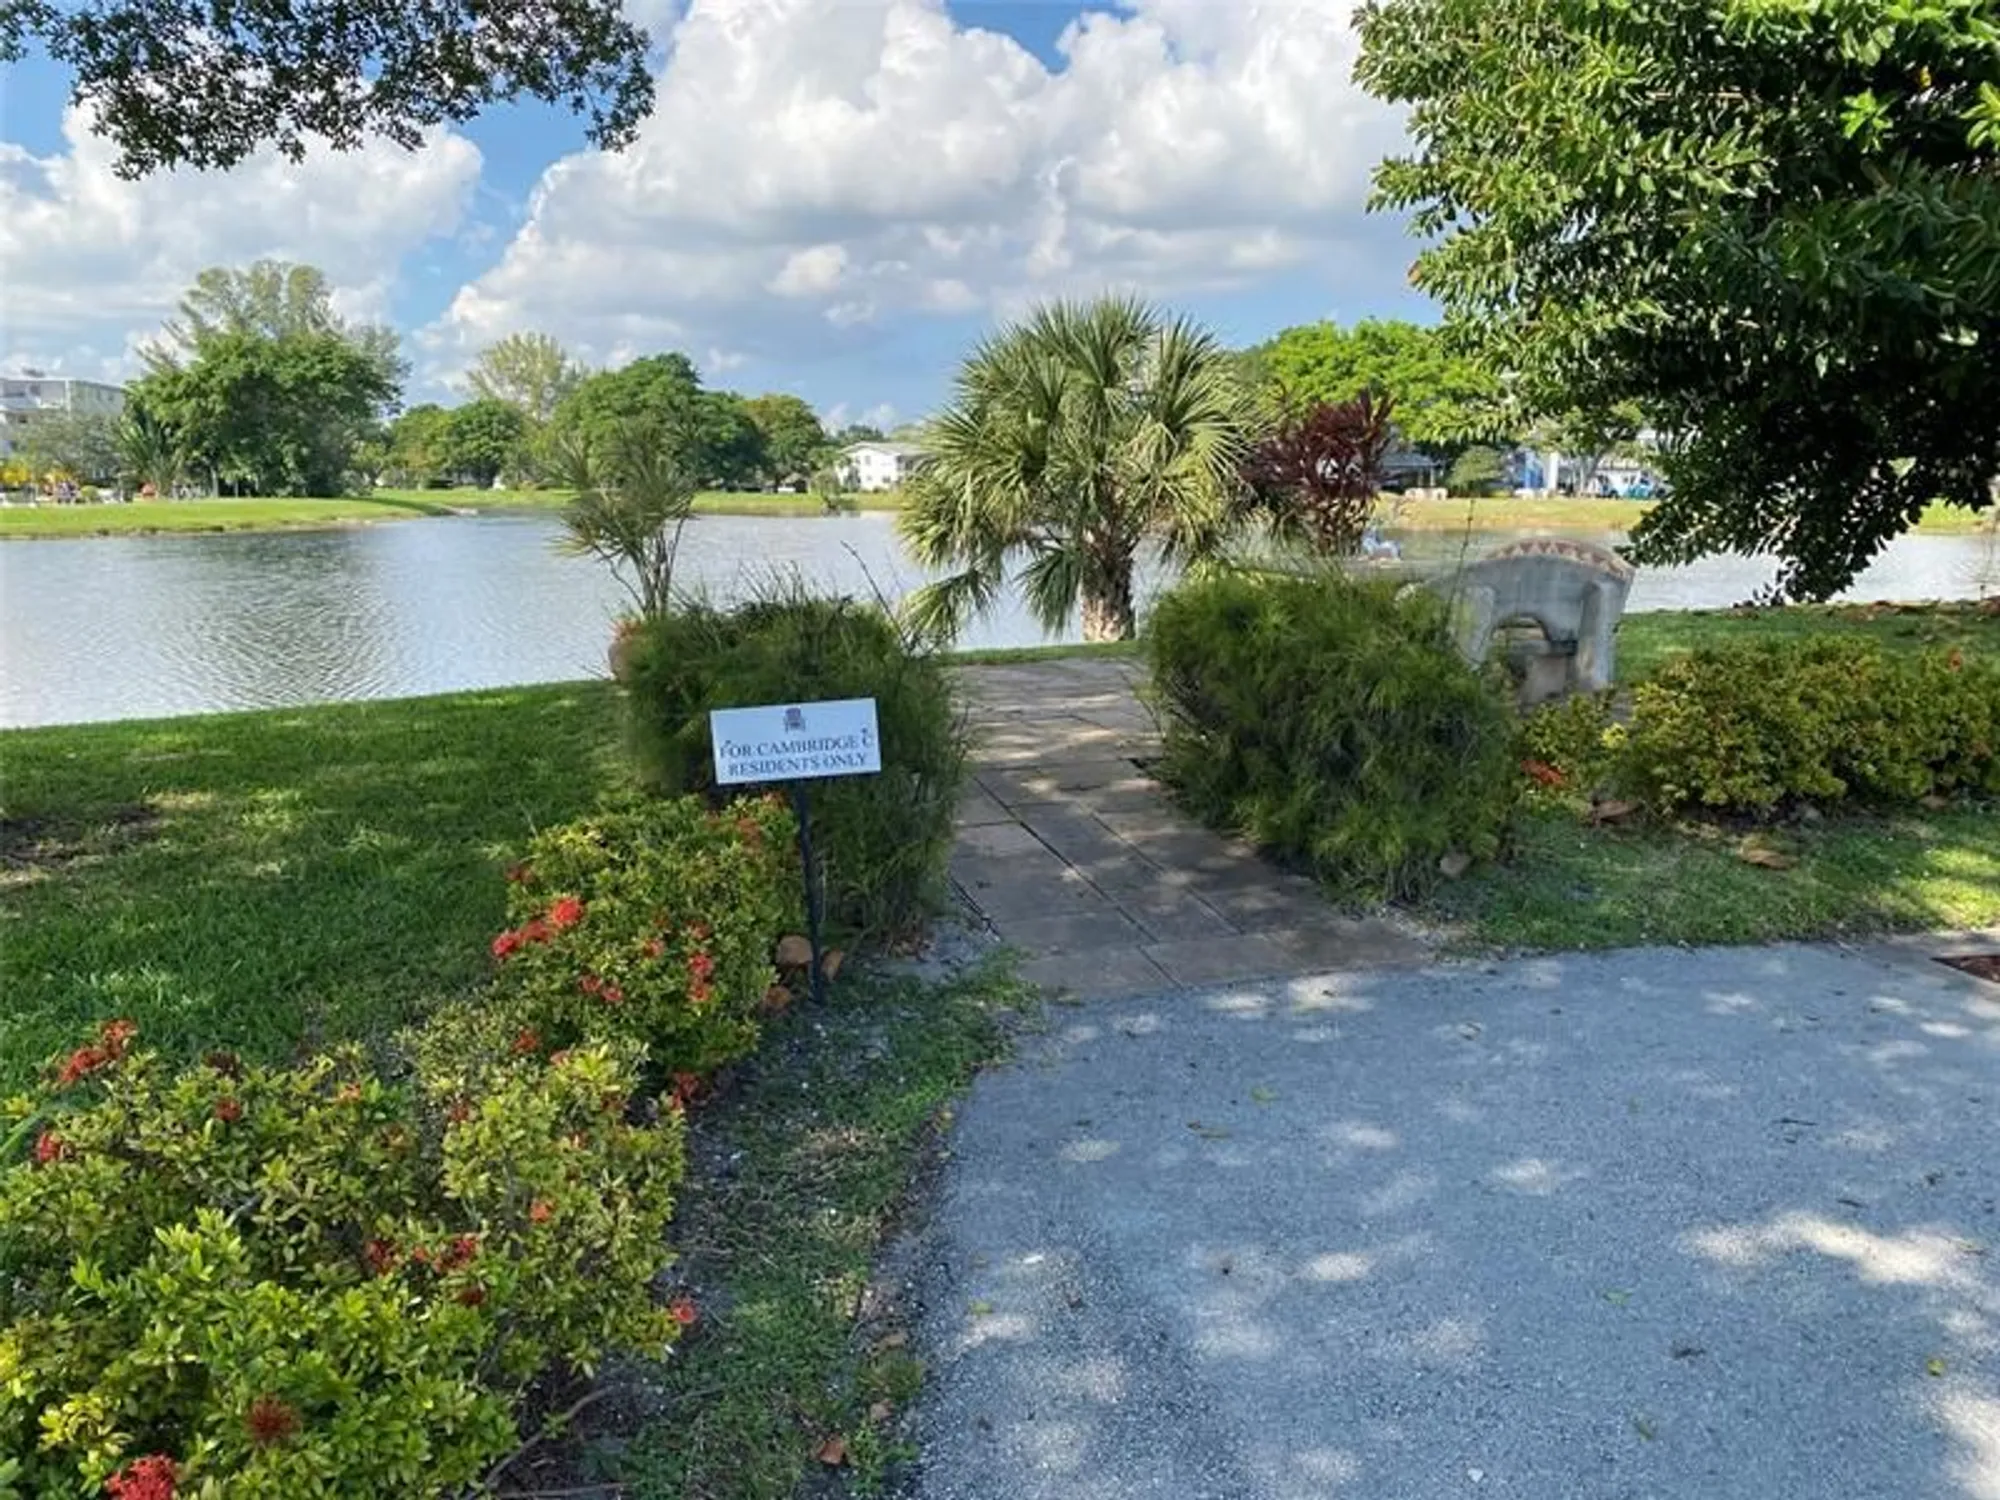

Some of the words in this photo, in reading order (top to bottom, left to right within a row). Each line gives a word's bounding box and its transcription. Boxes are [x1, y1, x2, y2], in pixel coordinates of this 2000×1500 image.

[757, 736, 857, 755] CAMBRIDGE
[729, 755, 821, 776] RESIDENTS
[823, 752, 866, 768] ONLY
